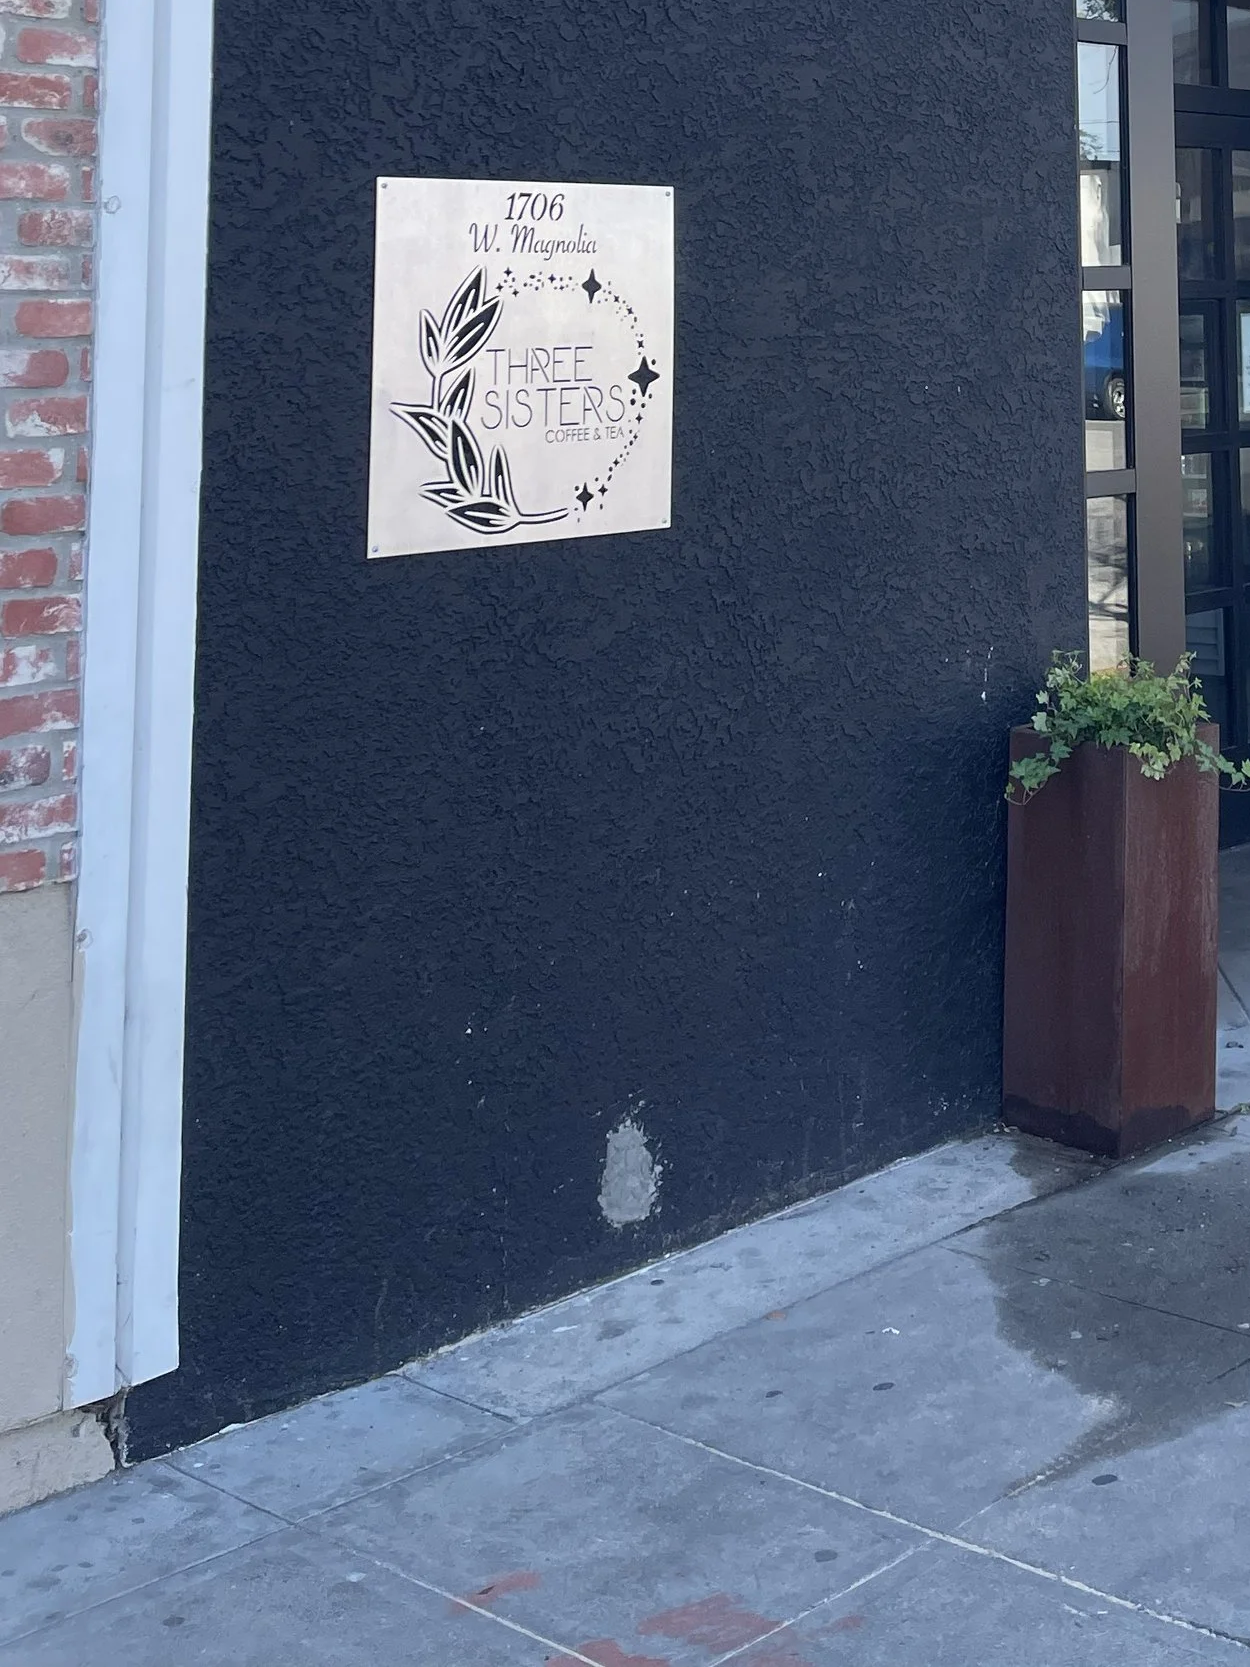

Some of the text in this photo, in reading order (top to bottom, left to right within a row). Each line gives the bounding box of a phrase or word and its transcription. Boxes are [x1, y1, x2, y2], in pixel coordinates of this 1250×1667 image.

[504, 192, 566, 222] 1706
[468, 222, 599, 261] W. Magnolia
[485, 346, 594, 386] THREE
[480, 384, 626, 430] SISTERS
[544, 425, 625, 445] COFFEE & TEA
